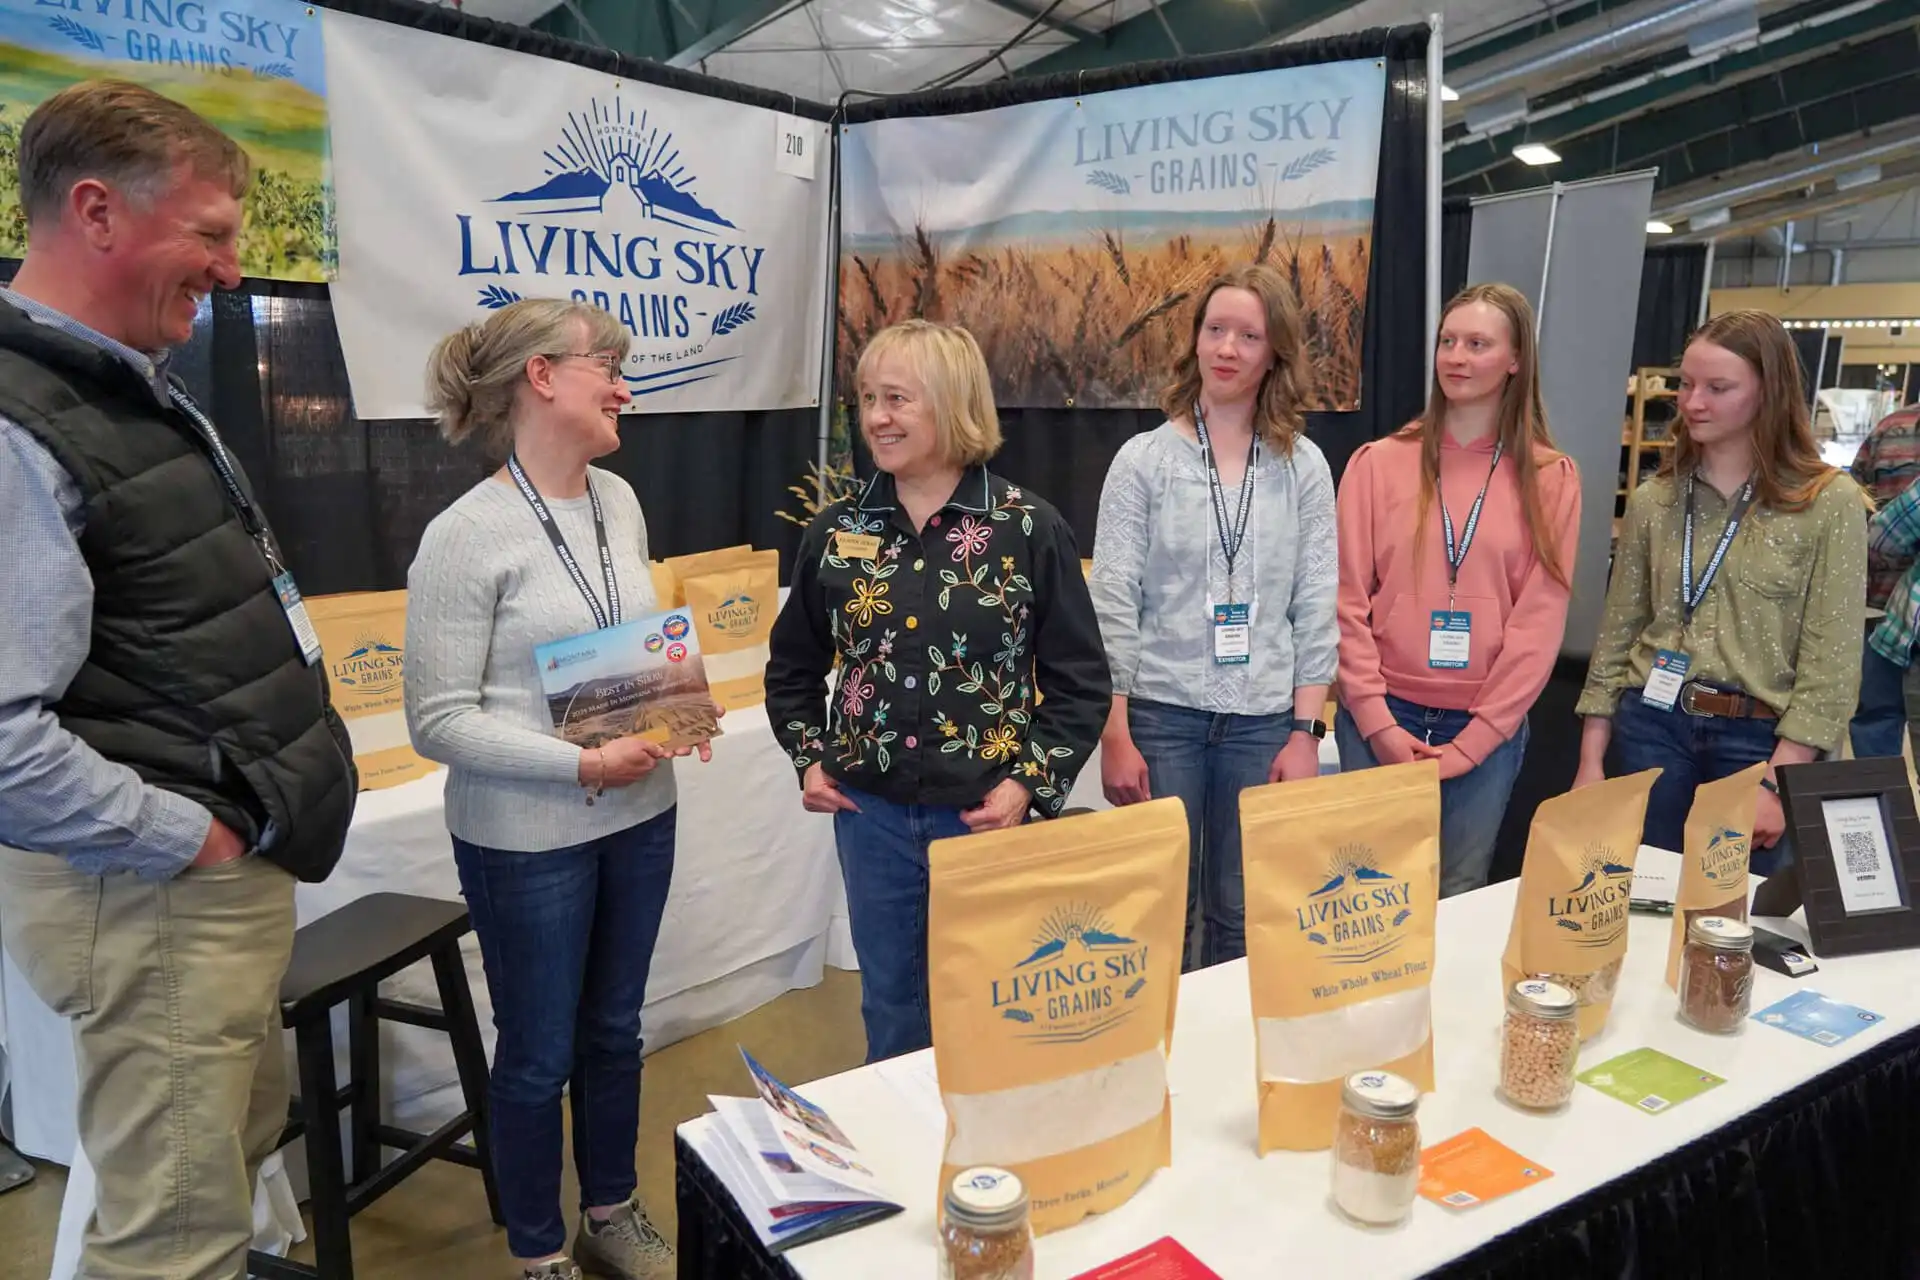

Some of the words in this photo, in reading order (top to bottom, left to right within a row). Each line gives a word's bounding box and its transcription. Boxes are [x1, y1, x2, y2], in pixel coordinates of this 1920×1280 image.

[35, 0, 206, 34] ING
[219, 10, 299, 61] SKY
[126, 28, 233, 78] GRAINS
[786, 132, 803, 156] 210
[1074, 109, 1235, 166] LIVING
[1247, 97, 1352, 141] SKY
[1150, 152, 1258, 195] GRAINS
[456, 214, 662, 280] LIVING
[673, 240, 765, 296] SKY
[631, 354, 648, 364] OF
[652, 352, 673, 363] THE
[676, 344, 704, 360] LAND
[332, 656, 384, 678] LIVING
[1296, 892, 1369, 931] LIVING
[1371, 882, 1410, 909] SKY
[1548, 886, 1616, 918] LIVING
[1591, 903, 1623, 930] GRAINS
[1333, 913, 1385, 943] GRAINS
[991, 960, 1097, 1008] LIVING
[1104, 946, 1148, 980] SKY
[1047, 985, 1112, 1020] GRAINS
